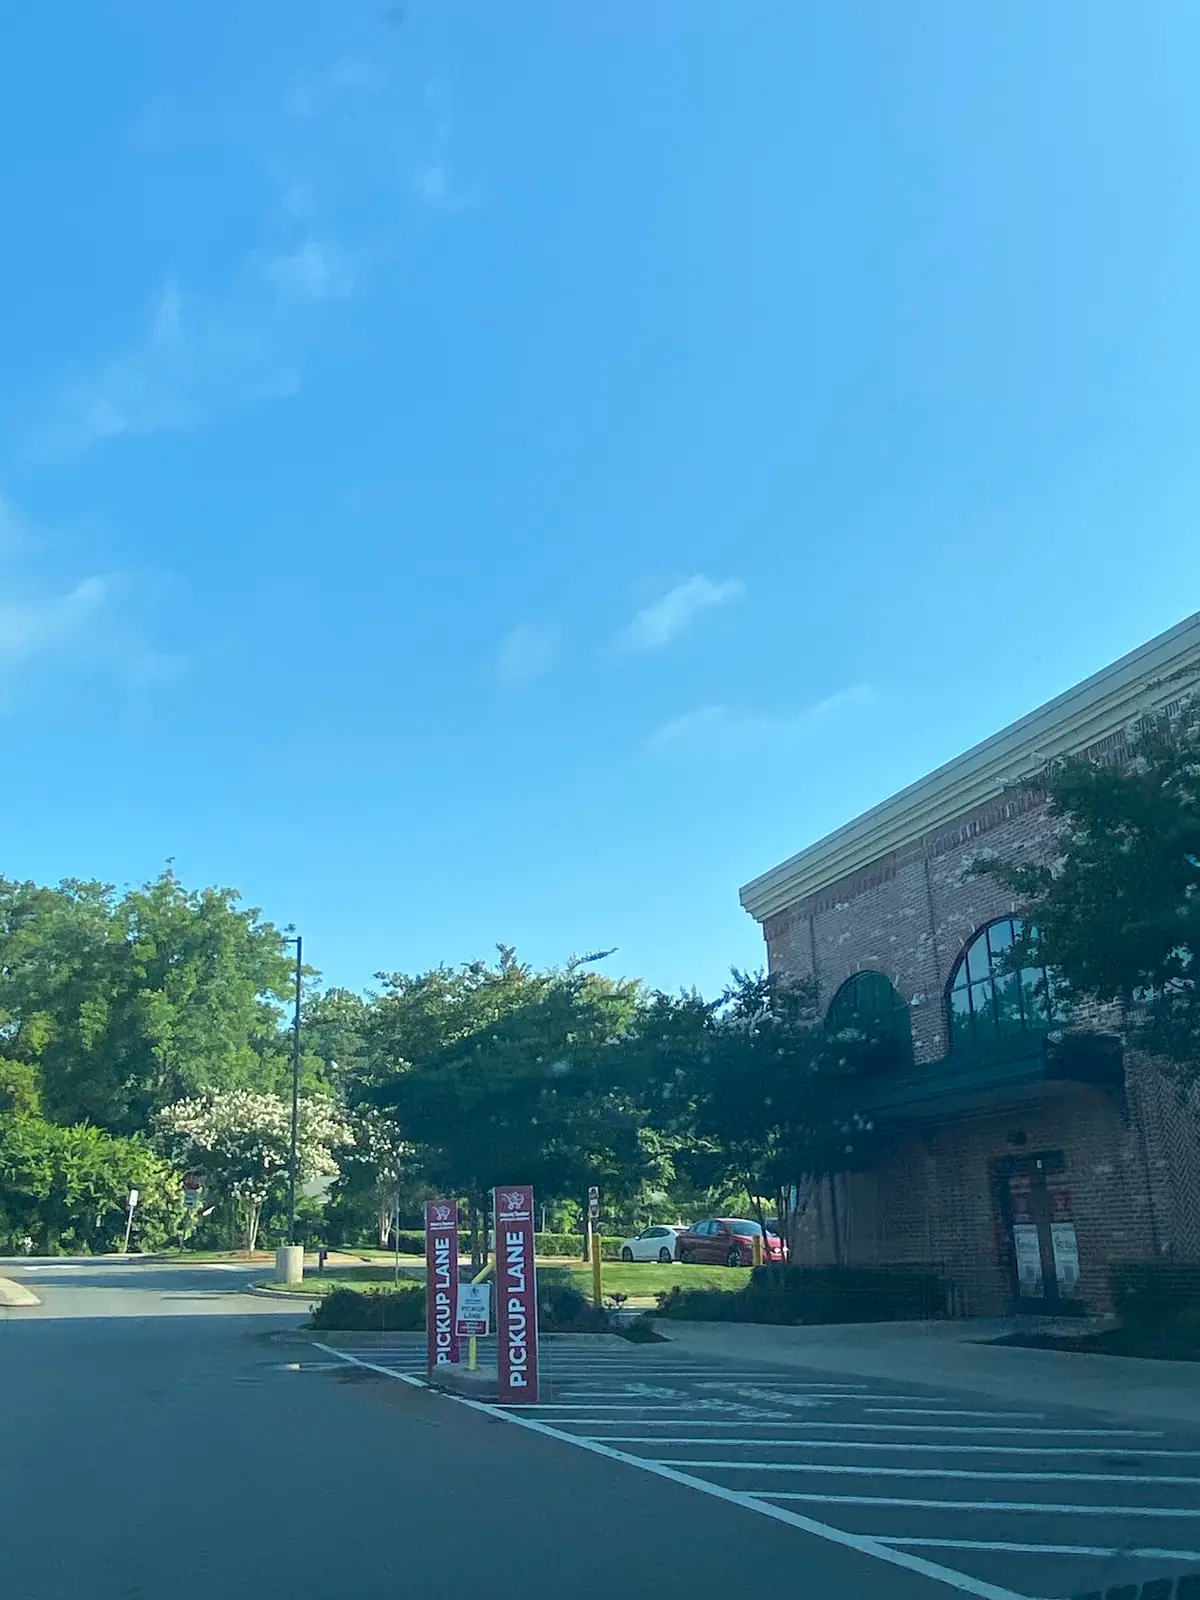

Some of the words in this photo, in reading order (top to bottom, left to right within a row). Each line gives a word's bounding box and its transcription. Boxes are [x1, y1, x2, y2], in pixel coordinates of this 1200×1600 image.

[434, 1237, 450, 1289] LANE
[506, 1231, 526, 1293] LANE
[435, 1292, 451, 1366] PICKUP
[508, 1298, 528, 1387] PICKUP
